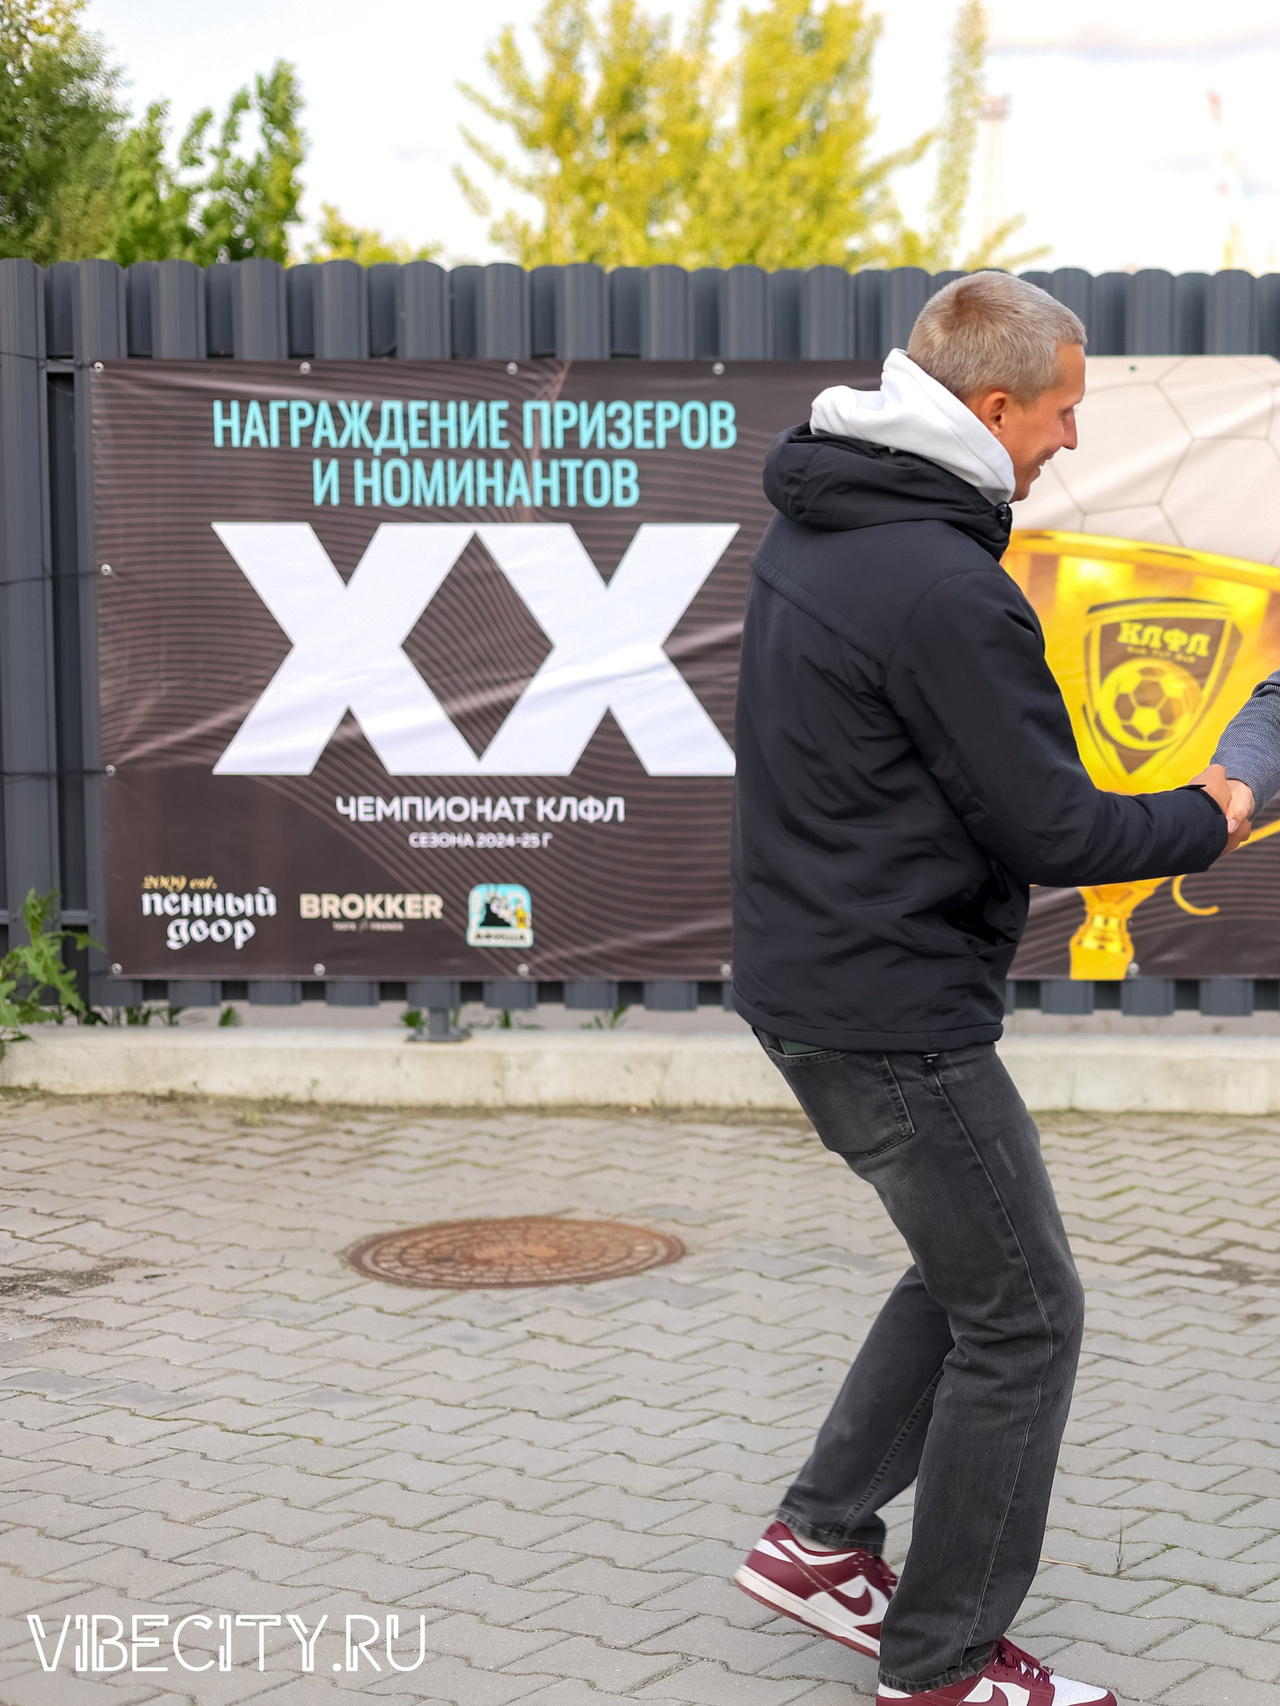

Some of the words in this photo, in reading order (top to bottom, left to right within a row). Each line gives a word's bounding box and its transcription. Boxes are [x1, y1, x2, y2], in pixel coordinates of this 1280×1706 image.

[213, 400, 510, 457] НАГРАЖДЕНИЕ
[522, 400, 738, 450] ПРИЗЕРОВ
[312, 458, 341, 507] И
[353, 458, 640, 508] НОМИНАНТОВ
[211, 522, 740, 776] XX
[1117, 621, 1211, 657] КЛФЛ
[335, 795, 531, 823] ЧЕМПИОНАТ
[536, 795, 626, 824] КЛФЛ
[408, 832, 474, 849] СЕЗОНА
[475, 832, 541, 849] 2024-25
[142, 874, 187, 893] 2009
[299, 892, 444, 920] BROKKER
